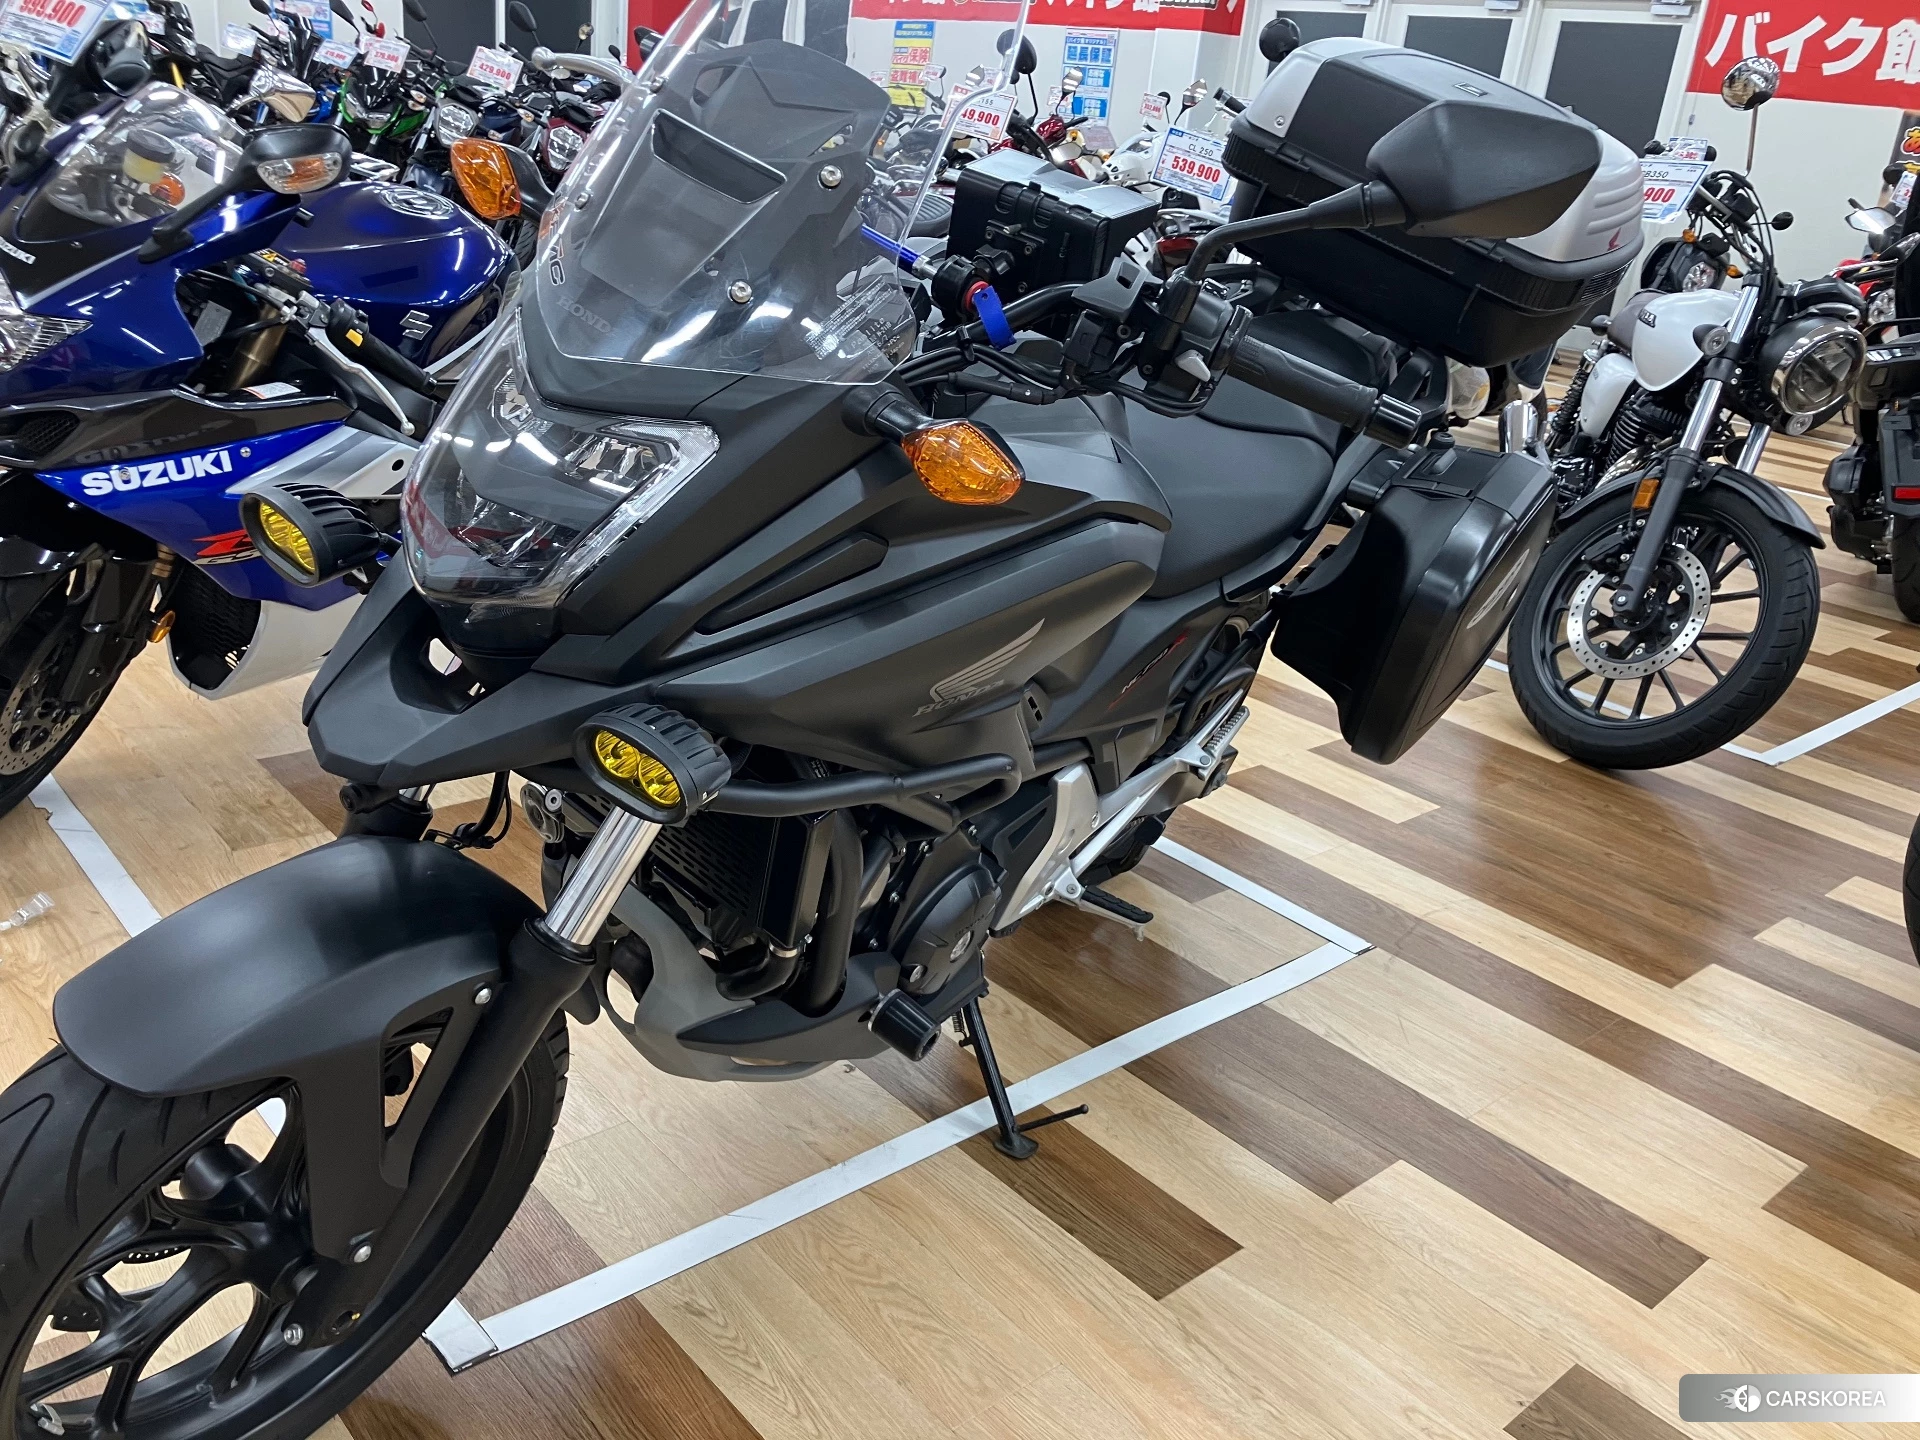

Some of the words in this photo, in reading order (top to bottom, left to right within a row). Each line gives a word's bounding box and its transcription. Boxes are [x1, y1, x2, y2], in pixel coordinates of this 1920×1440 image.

[1171, 155, 1221, 183] 539,900
[1188, 143, 1197, 152] CL
[1199, 147, 1214, 157] 250
[556, 295, 617, 336] HOND
[80, 449, 233, 496] SUZUKI
[911, 679, 1005, 718] HONDA
